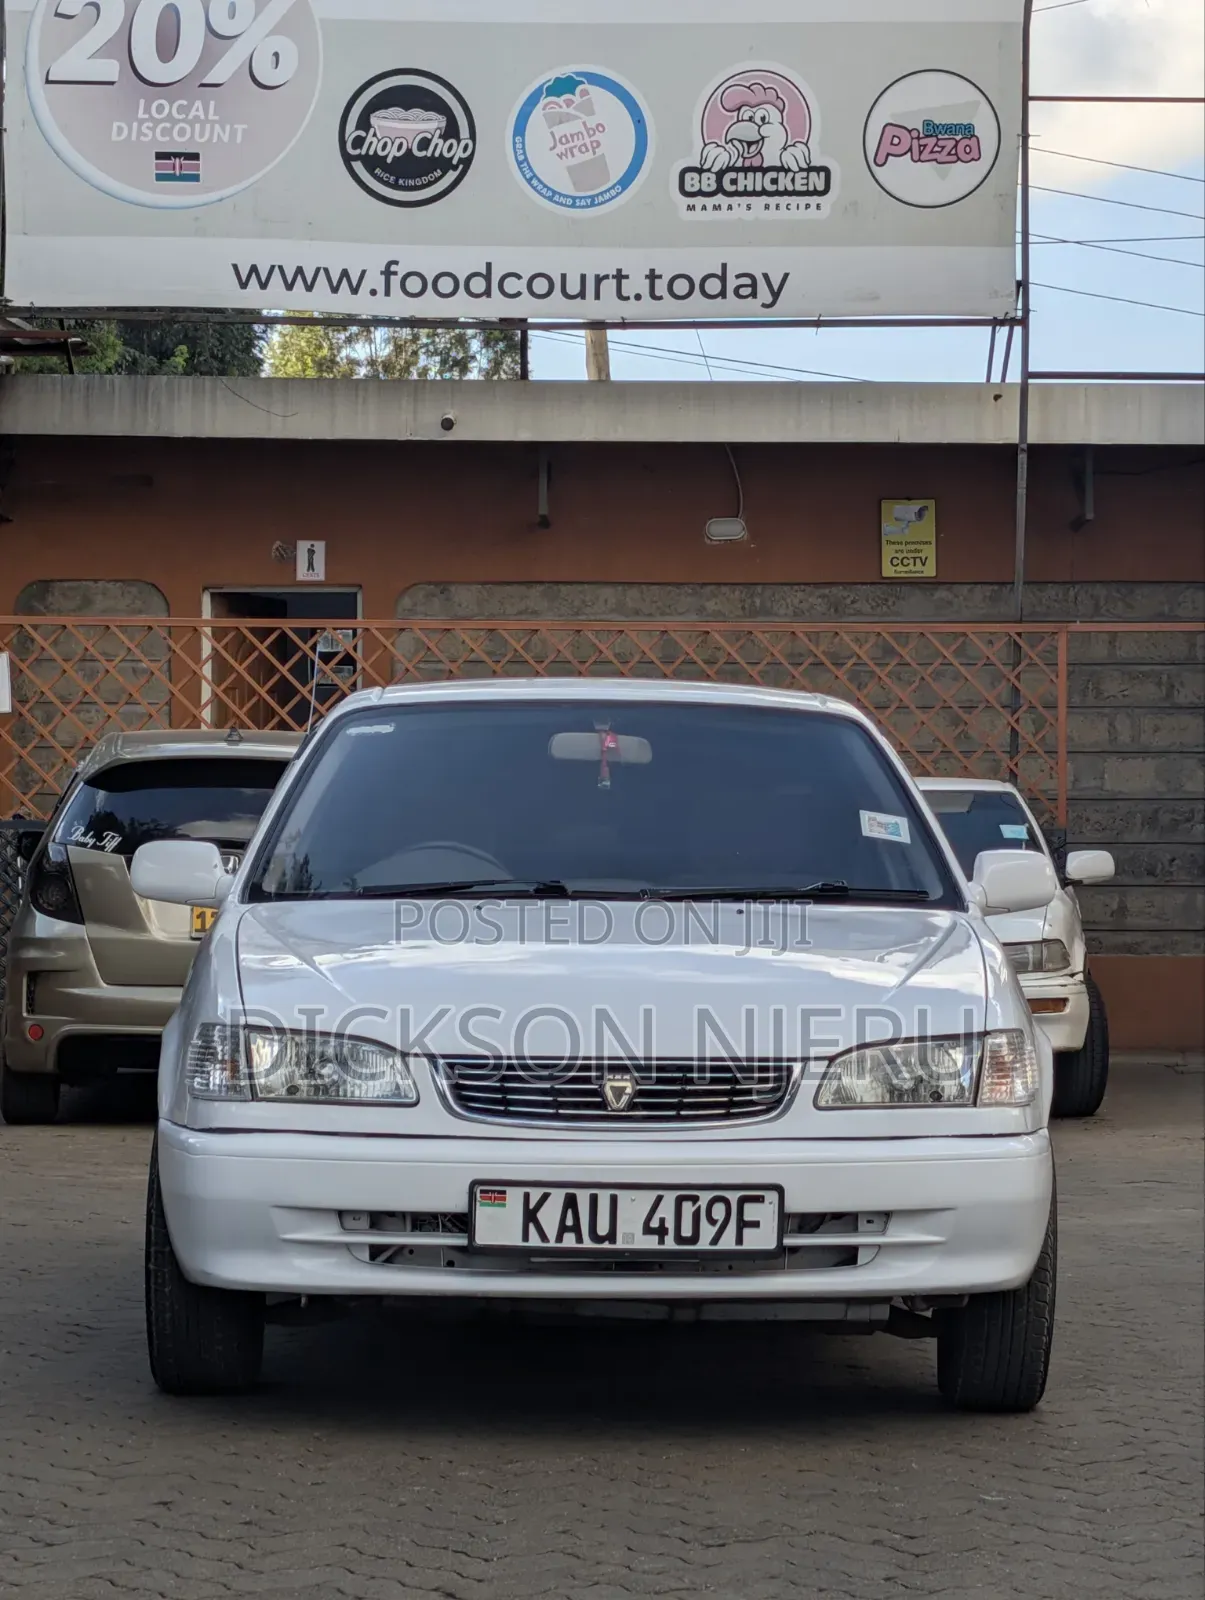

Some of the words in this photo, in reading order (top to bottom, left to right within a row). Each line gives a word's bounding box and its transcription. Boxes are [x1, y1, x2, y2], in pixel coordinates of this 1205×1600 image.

[45, 0, 299, 89] 20%
[137, 98, 220, 121] LOCAL
[110, 121, 248, 144] DISCOUNT
[549, 120, 606, 152] Jambo
[922, 119, 975, 137] Bwana
[346, 127, 408, 164] Chop
[411, 128, 474, 165] Chop
[556, 139, 602, 161] wrap
[873, 122, 981, 167] Pizza
[374, 167, 396, 184] RICE
[398, 168, 443, 187] KINGDOM
[515, 135, 525, 162] GRAB
[520, 162, 534, 180] THE
[530, 178, 553, 198] WRAP
[552, 195, 573, 206] AND
[575, 198, 592, 207] SAY
[593, 184, 622, 205] JAMBO
[684, 171, 717, 193] BB
[722, 171, 826, 193] CHICKEN
[686, 203, 752, 212] MAMA'S
[763, 203, 822, 211] RECIPE
[231, 259, 790, 309] www.foodcourt.today
[889, 556, 928, 567] CCTV
[67, 825, 97, 849] Baby
[194, 910, 219, 932] 1
[522, 1191, 617, 1245] KAU
[642, 1193, 766, 1246] 409F
